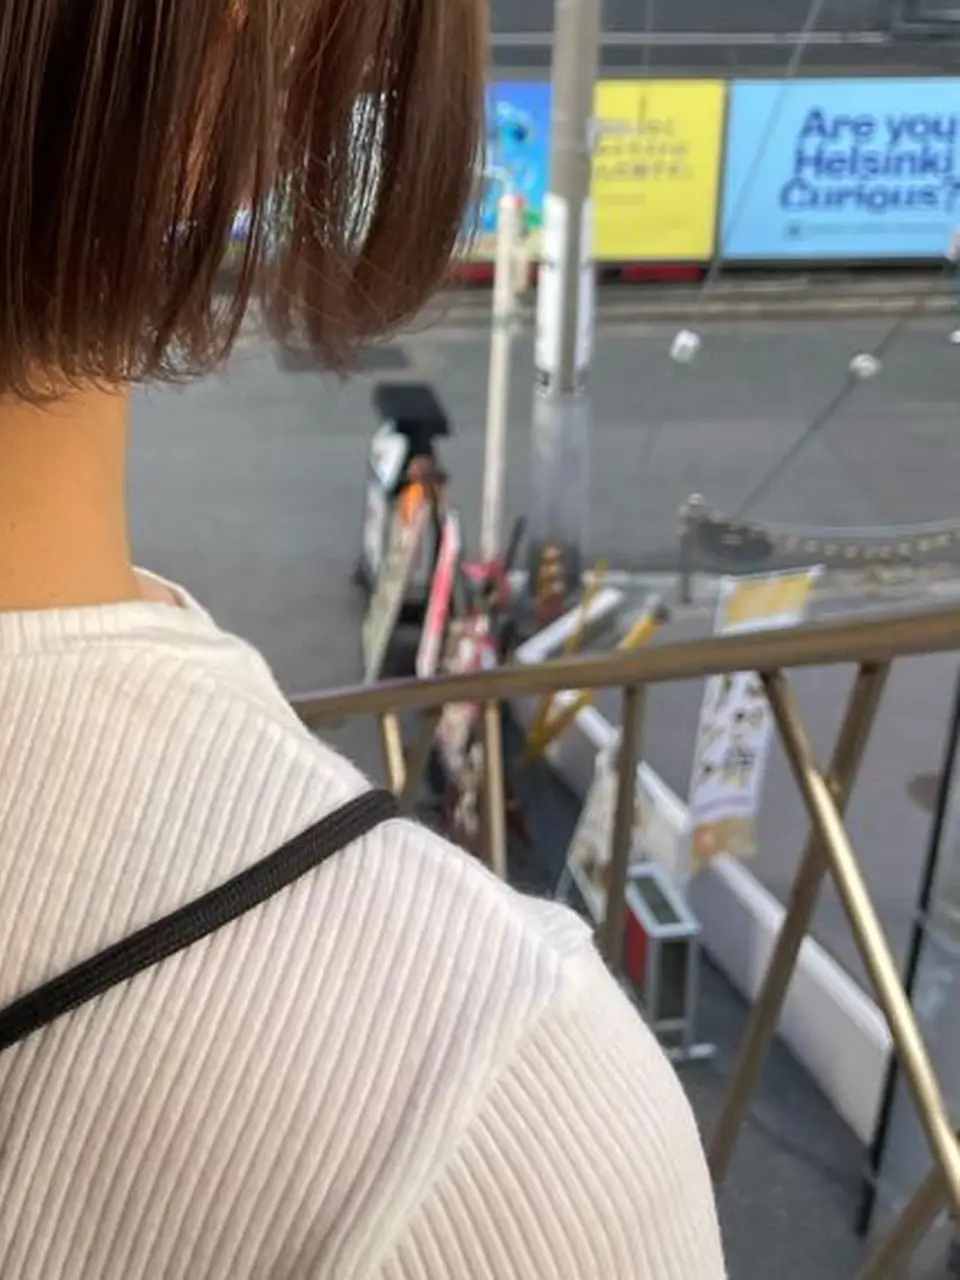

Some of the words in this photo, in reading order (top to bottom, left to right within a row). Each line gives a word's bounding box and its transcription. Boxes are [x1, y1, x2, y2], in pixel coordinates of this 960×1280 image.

[798, 106, 874, 141] Are
[885, 113, 956, 151] you
[794, 143, 953, 178] Helsinki
